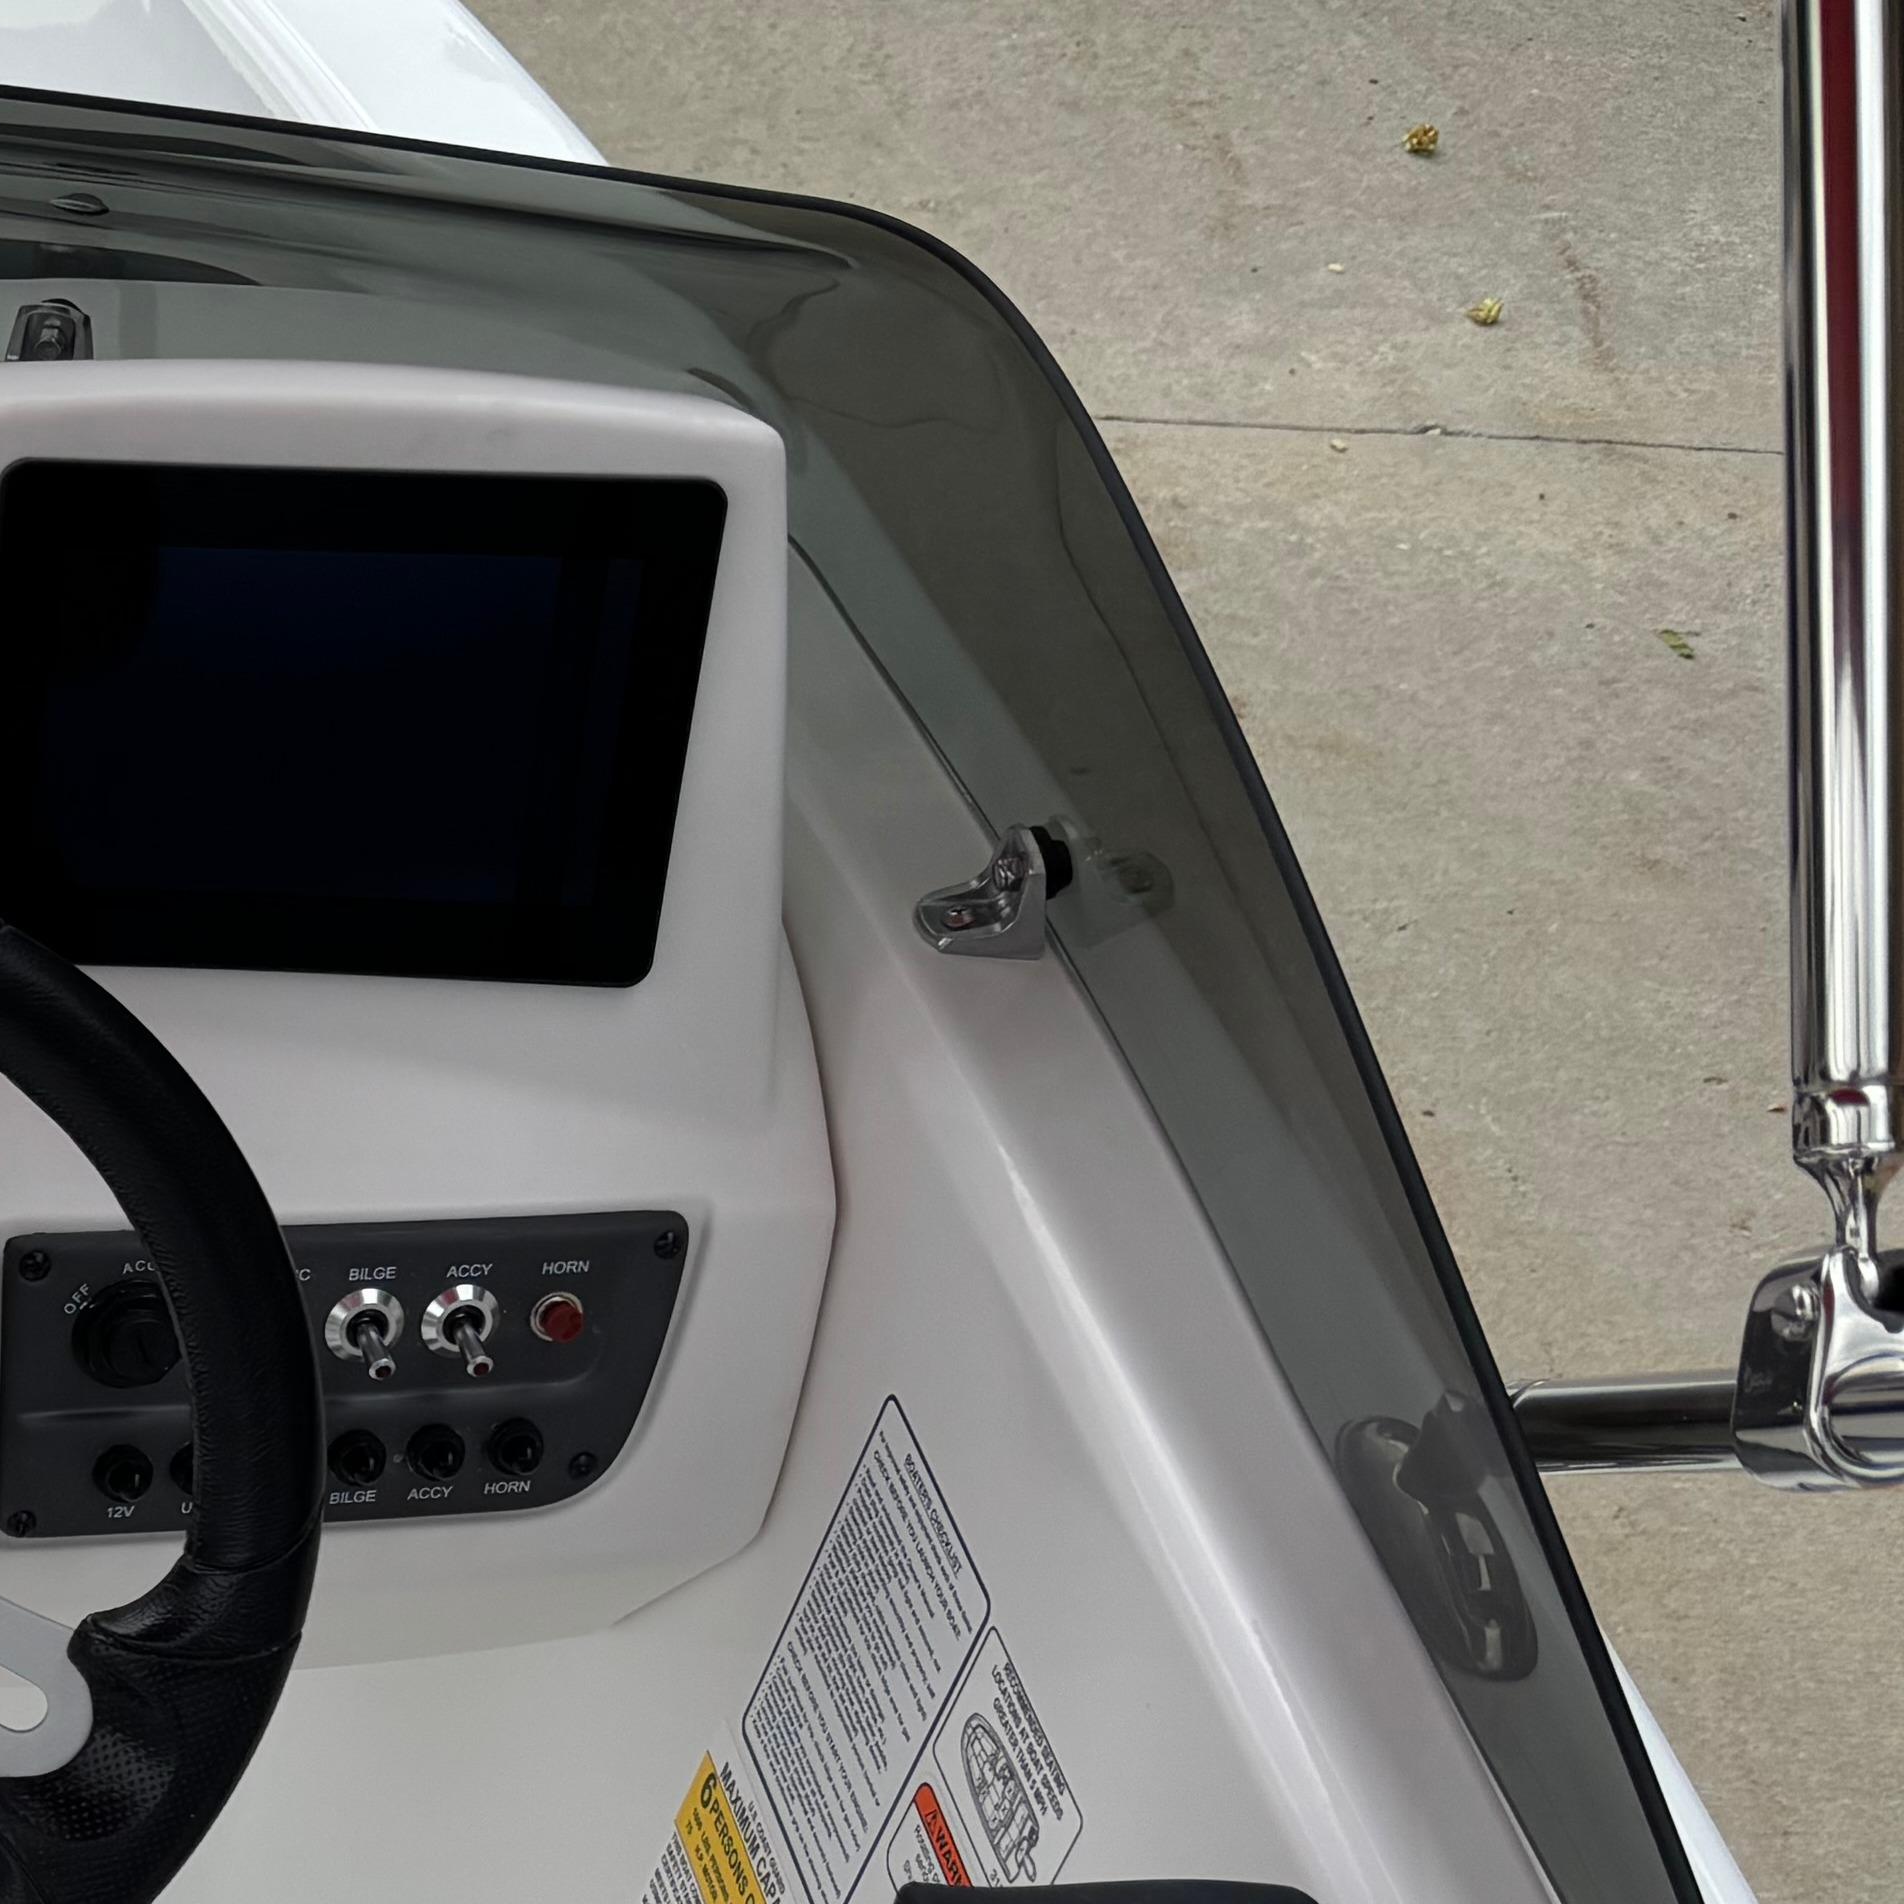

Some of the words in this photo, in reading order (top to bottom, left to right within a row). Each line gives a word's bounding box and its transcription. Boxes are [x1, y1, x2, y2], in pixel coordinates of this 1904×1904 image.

[348, 1266, 397, 1281] BILGE
[446, 1263, 493, 1278] ACCY
[542, 1260, 590, 1275] HORN
[407, 1486, 453, 1501] ACCY
[484, 1480, 531, 1495] HORN
[329, 1490, 377, 1505] BILGE
[107, 1505, 135, 1519] 12V
[720, 1762, 759, 1858] MAXIMUM
[700, 1772, 716, 1808] 6
[709, 1798, 747, 1895] PERSONS
